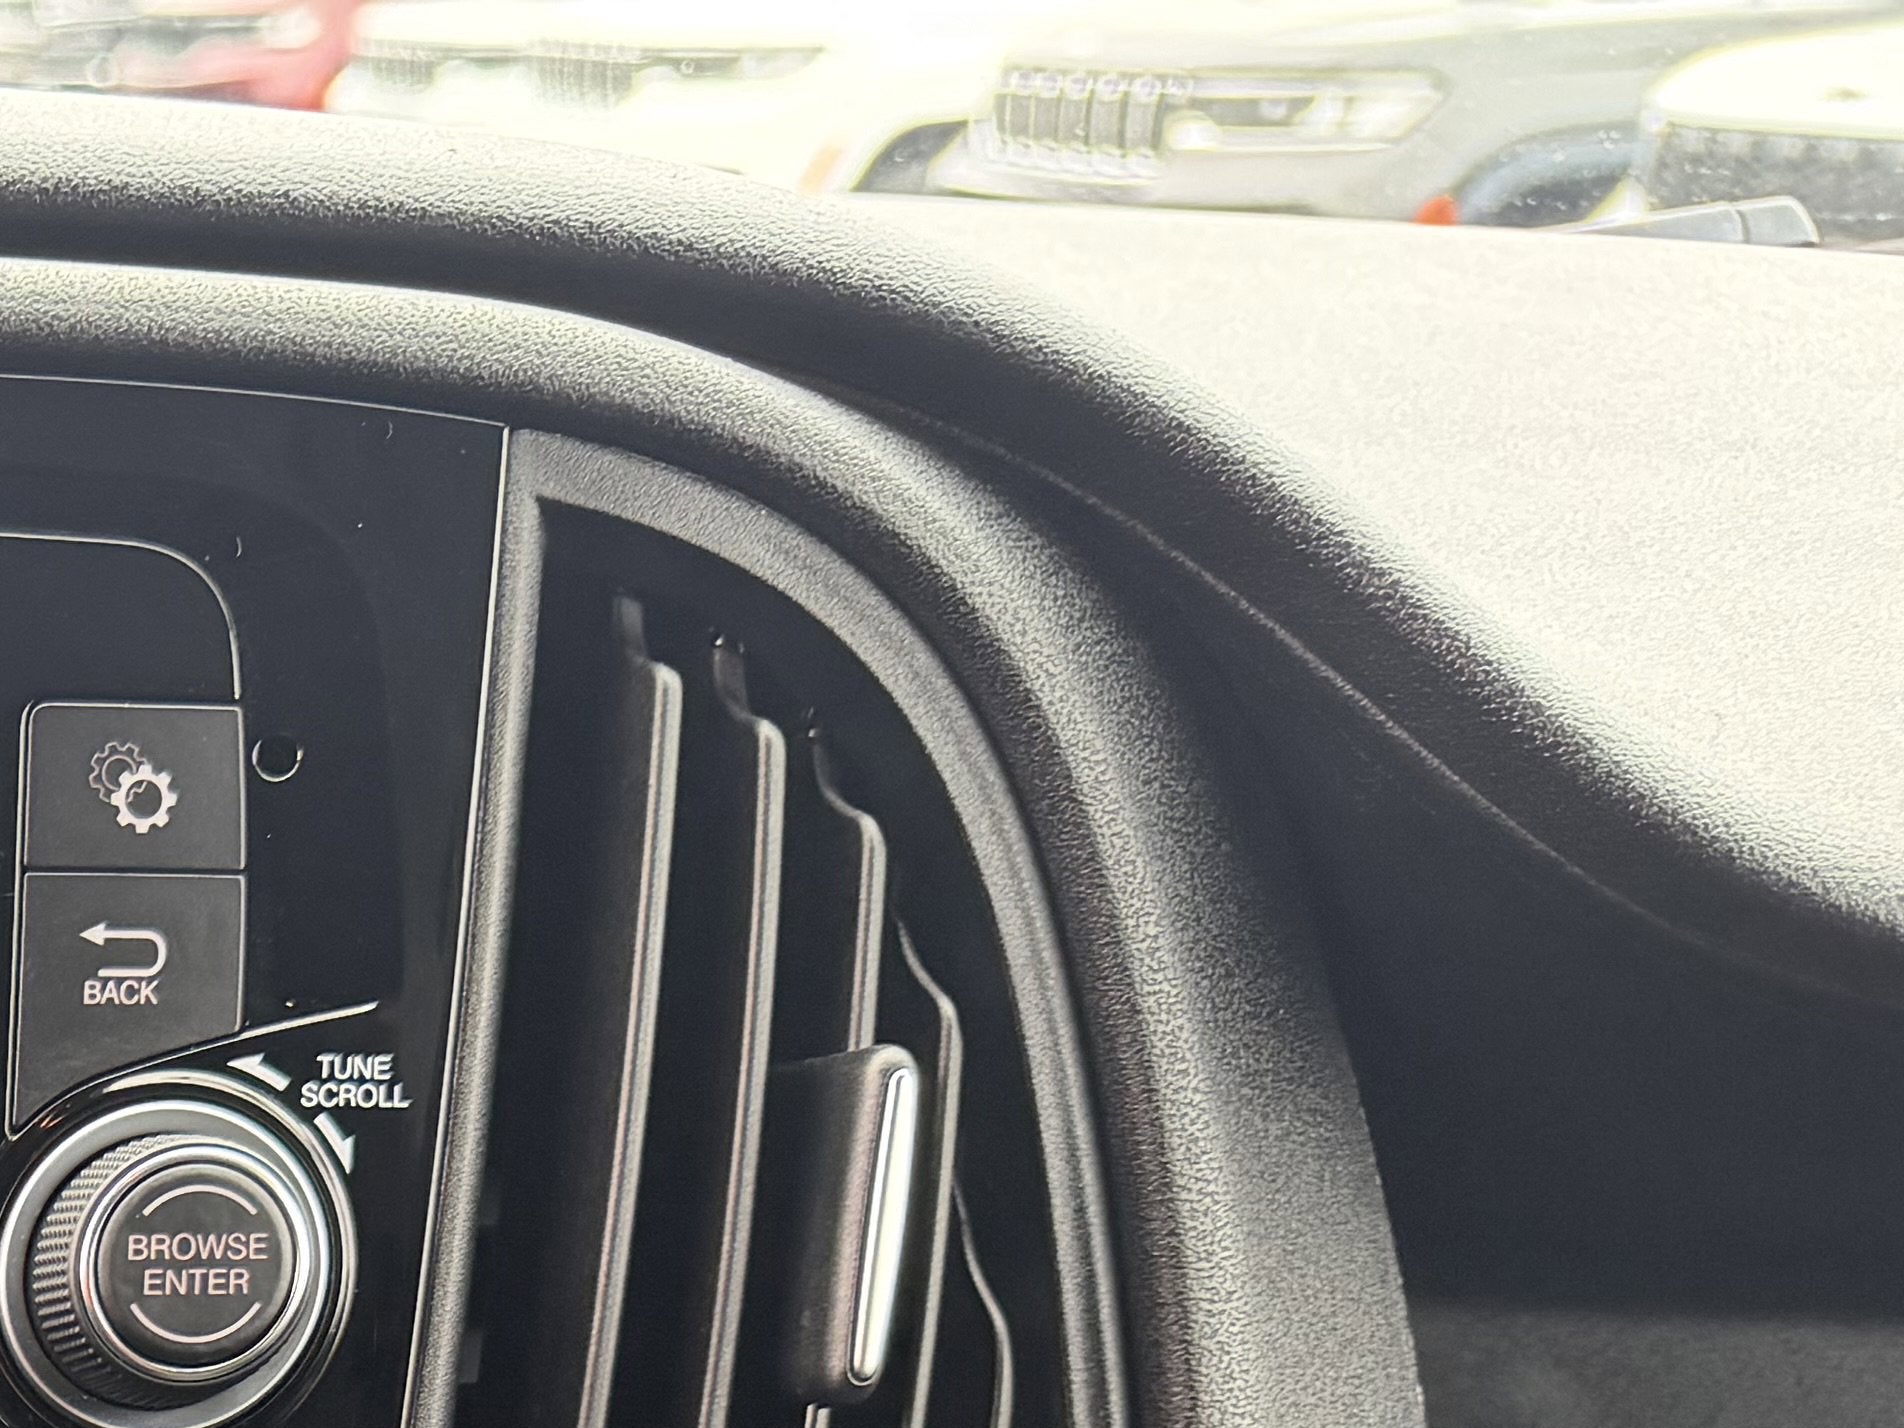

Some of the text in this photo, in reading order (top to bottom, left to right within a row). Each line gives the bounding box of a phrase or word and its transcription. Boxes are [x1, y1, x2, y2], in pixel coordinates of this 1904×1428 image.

[83, 977, 159, 1005] BACK
[315, 1053, 394, 1081] TUNE
[299, 1079, 413, 1109] SCROLL
[127, 1232, 269, 1262] BROWSE
[143, 1267, 250, 1297] ENTER
